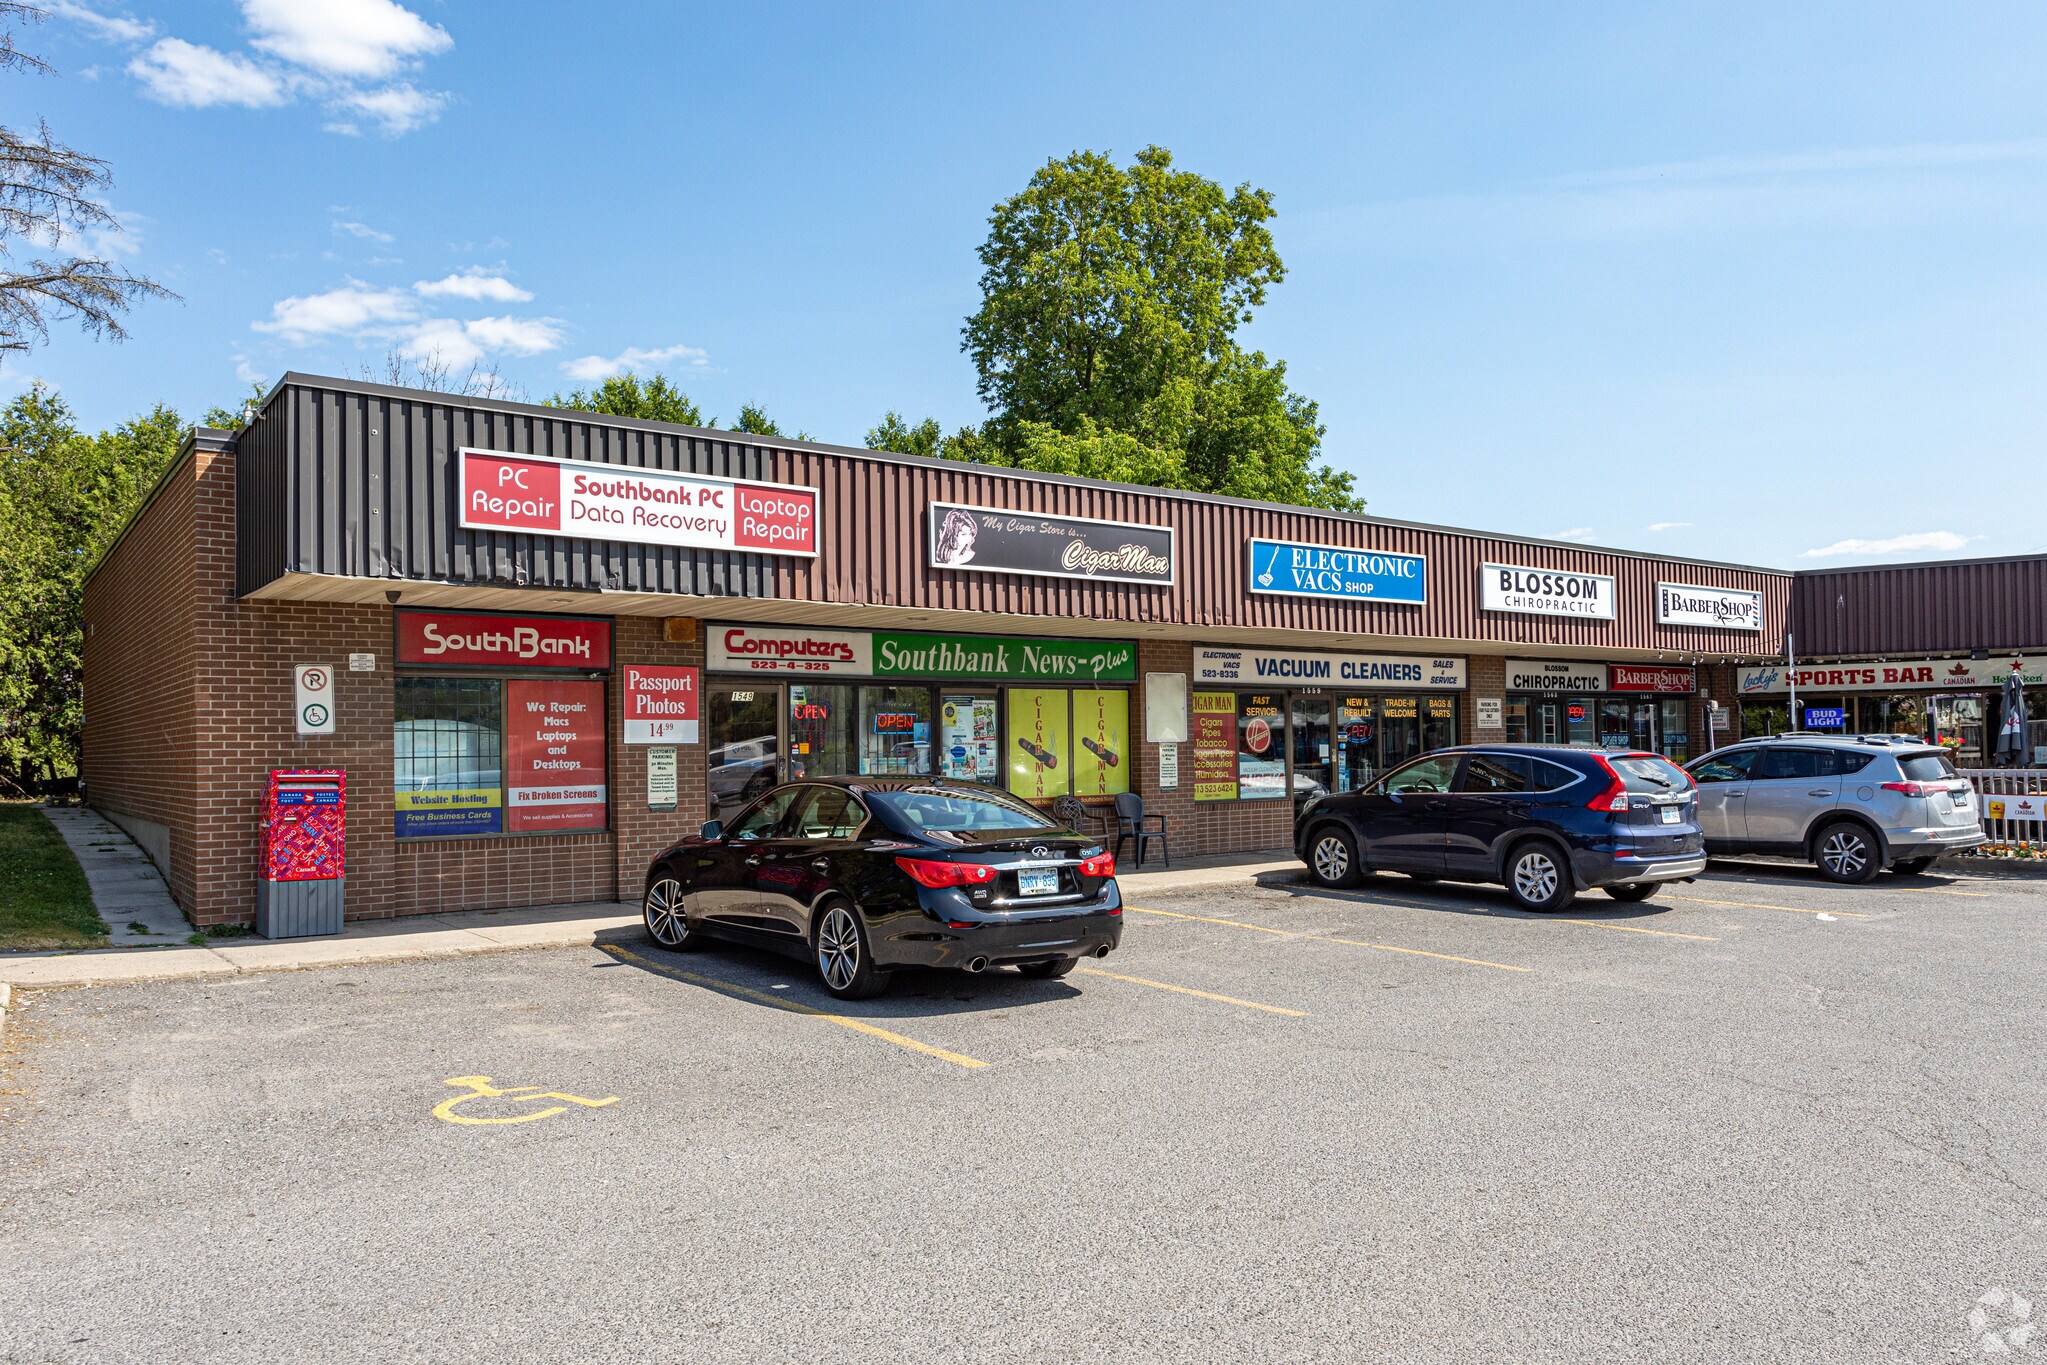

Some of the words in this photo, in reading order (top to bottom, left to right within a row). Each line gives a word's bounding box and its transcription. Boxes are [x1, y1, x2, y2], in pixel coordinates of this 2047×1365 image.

[498, 466, 529, 490] PC
[573, 475, 692, 506] Southbank
[699, 487, 724, 509] PC
[472, 490, 555, 520] Repair
[740, 492, 811, 519] Laptop
[571, 500, 624, 524] Data
[632, 506, 727, 538] Recovery
[743, 517, 809, 543] Repair
[982, 516, 1003, 531] My
[1007, 519, 1037, 535] Cigar
[1039, 522, 1066, 536] Store
[1068, 527, 1087, 538] is...
[1291, 548, 1416, 578] ELECTRONIC
[1292, 569, 1342, 592] VACS
[1345, 582, 1374, 594] SHOP
[1500, 570, 1598, 600] BLOSSOM
[1504, 595, 1596, 614] CHIROPRACTIC
[423, 623, 591, 658] SouthBank
[724, 629, 854, 660] Computers
[879, 640, 1011, 673] Southbank
[1202, 651, 1242, 660] ELECTRONIC
[751, 661, 830, 671] 523-4-325
[1223, 661, 1241, 669] VACS
[1255, 658, 1330, 678] VACUUM
[1340, 661, 1422, 681] CLEANERS
[1432, 660, 1454, 668] SALES
[1544, 664, 1569, 673] BLOSSOM
[1202, 669, 1239, 678] 523-8336
[1743, 668, 1778, 690] Lucky's
[1785, 668, 1875, 687] SPORTS
[1883, 666, 1934, 684] BAR
[629, 670, 691, 694] Passport
[1430, 676, 1458, 684] SERVICE
[1513, 674, 1599, 690] CHIROPRACTIC
[1943, 677, 1975, 685] CANADIAN
[733, 692, 753, 701] 1549
[1252, 696, 1270, 705] FAST
[1346, 698, 1358, 706] NEW
[1363, 698, 1368, 706] &
[527, 702, 545, 712] We
[550, 702, 586, 714] Repair:
[636, 694, 685, 715] Photos
[1215, 697, 1232, 710] MAN
[1385, 699, 1416, 707] TRADE-IN
[1429, 699, 1445, 708] BAGS
[794, 704, 827, 720] OPEN
[1343, 708, 1371, 717] REBUILT
[1384, 709, 1417, 718] WELCOME
[1431, 710, 1450, 718] PARTS
[1568, 706, 1585, 717] PEN
[1812, 710, 1837, 719] BUD
[544, 716, 569, 726] Macs
[877, 715, 913, 728] OPEN
[1035, 696, 1043, 756] CIGAR
[1097, 696, 1105, 755] CIGAR
[1200, 718, 1223, 728] Cigars
[1807, 717, 1842, 727] LIGHT
[536, 731, 577, 742] Laptops
[1202, 728, 1221, 738] Pipes
[1195, 739, 1227, 747] Tobacco
[548, 745, 567, 755] and
[533, 760, 581, 771] Desktops
[1035, 762, 1044, 797] MAN
[1097, 760, 1106, 794] MAN
[1195, 770, 1229, 779] Humidors
[1205, 784, 1216, 793] 523
[410, 795, 448, 805] Website
[451, 794, 488, 804] Hosting
[518, 791, 530, 801] Fix
[531, 791, 562, 800] Broken
[563, 789, 598, 799] Screens
[427, 812, 465, 821] Business
[468, 811, 492, 819] Cards
